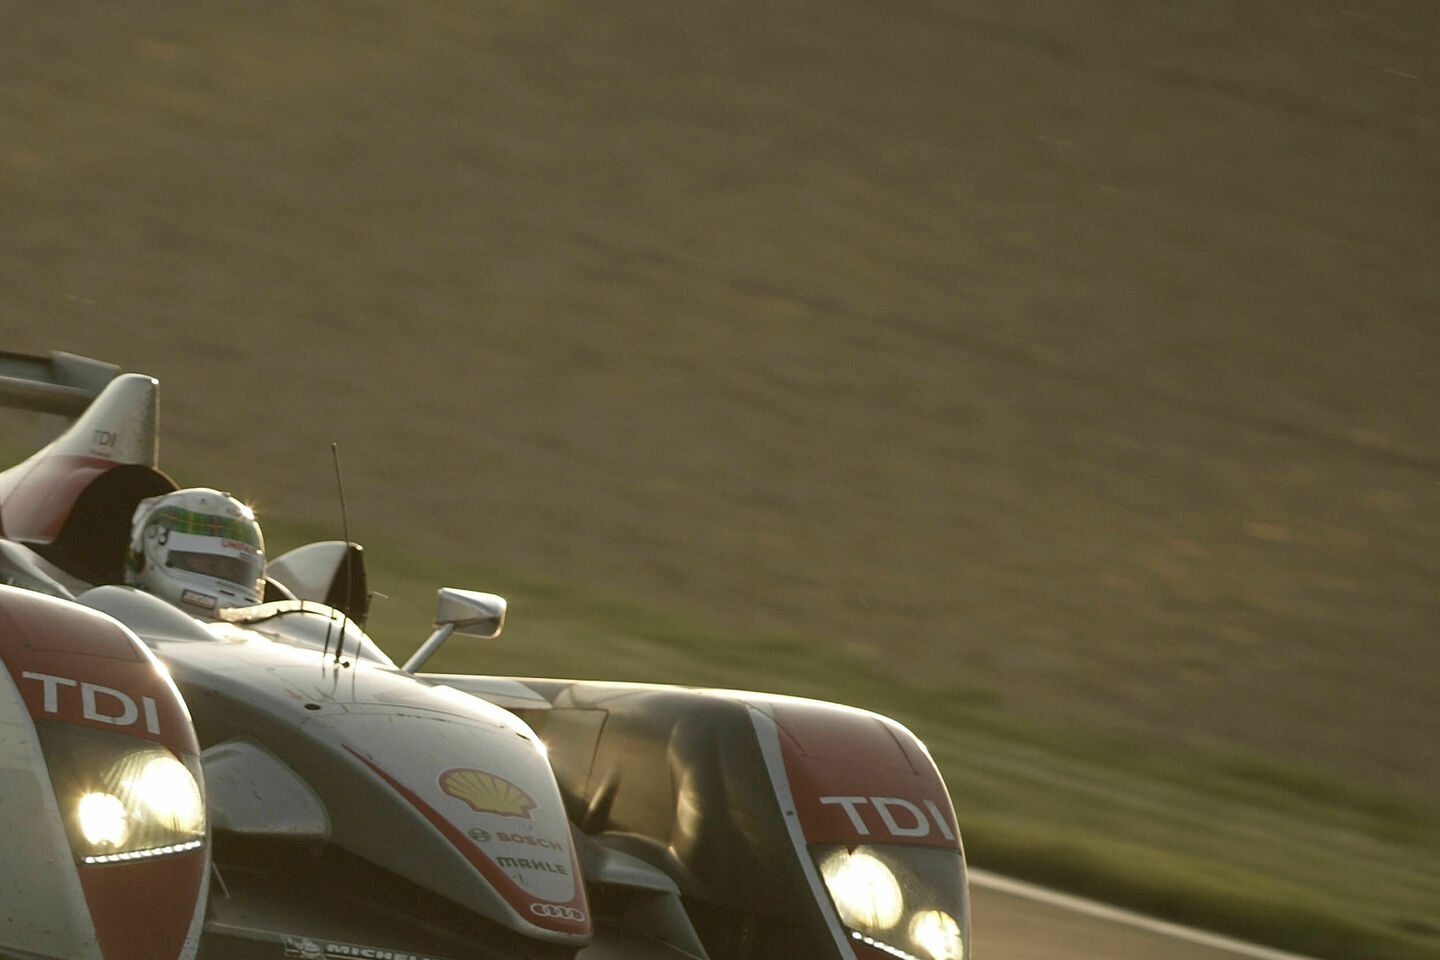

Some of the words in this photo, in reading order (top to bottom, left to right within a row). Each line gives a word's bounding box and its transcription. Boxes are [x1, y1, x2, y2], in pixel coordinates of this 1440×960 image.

[21, 670, 160, 735] TDI
[818, 796, 955, 841] TDI
[496, 831, 564, 852] BOSCH
[496, 857, 569, 876] MAHLE
